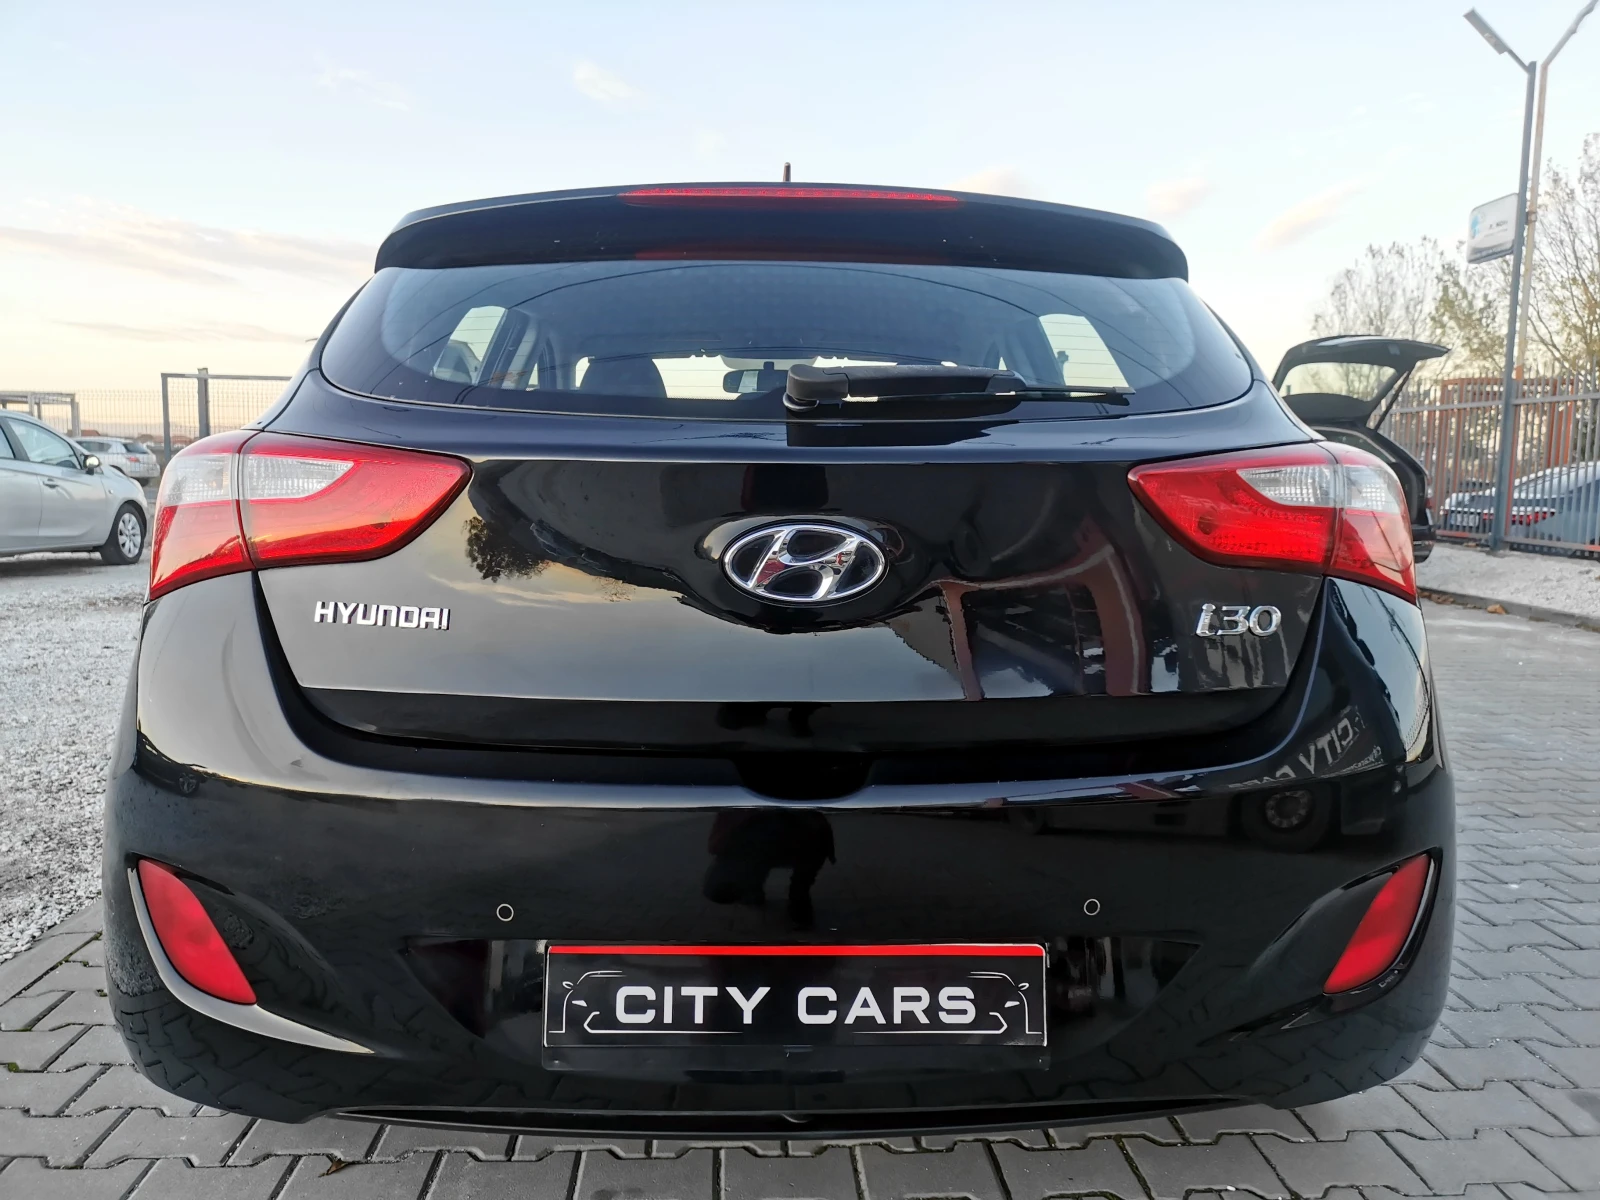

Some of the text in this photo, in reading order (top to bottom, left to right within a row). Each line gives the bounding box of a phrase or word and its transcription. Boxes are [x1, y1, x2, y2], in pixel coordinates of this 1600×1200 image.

[314, 601, 450, 630] HYUNDAI
[1196, 603, 1282, 636] i30
[615, 986, 976, 1025] CITY CARS
